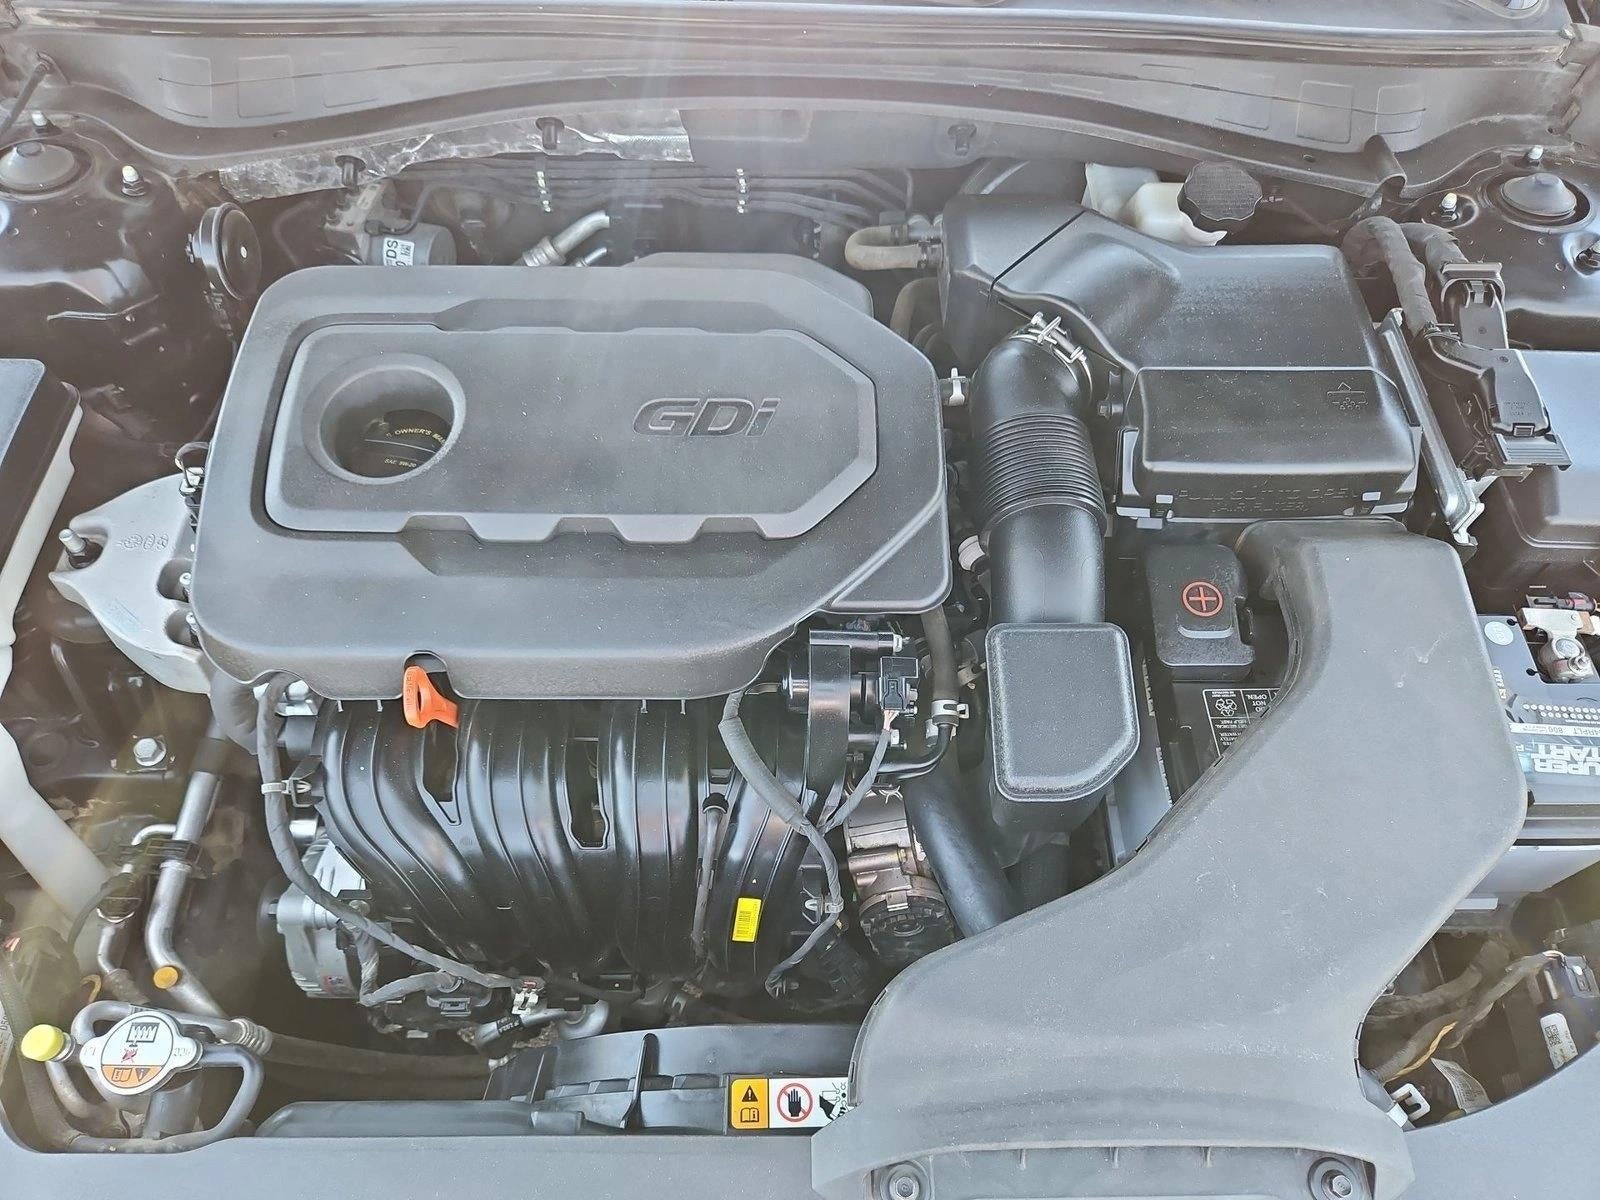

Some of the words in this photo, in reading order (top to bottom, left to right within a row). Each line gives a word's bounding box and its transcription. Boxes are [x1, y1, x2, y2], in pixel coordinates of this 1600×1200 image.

[632, 397, 782, 437] GDi
[1573, 727, 1600, 737] 4RPLT
[1531, 743, 1600, 762] TART
[1533, 757, 1600, 776] UPER
